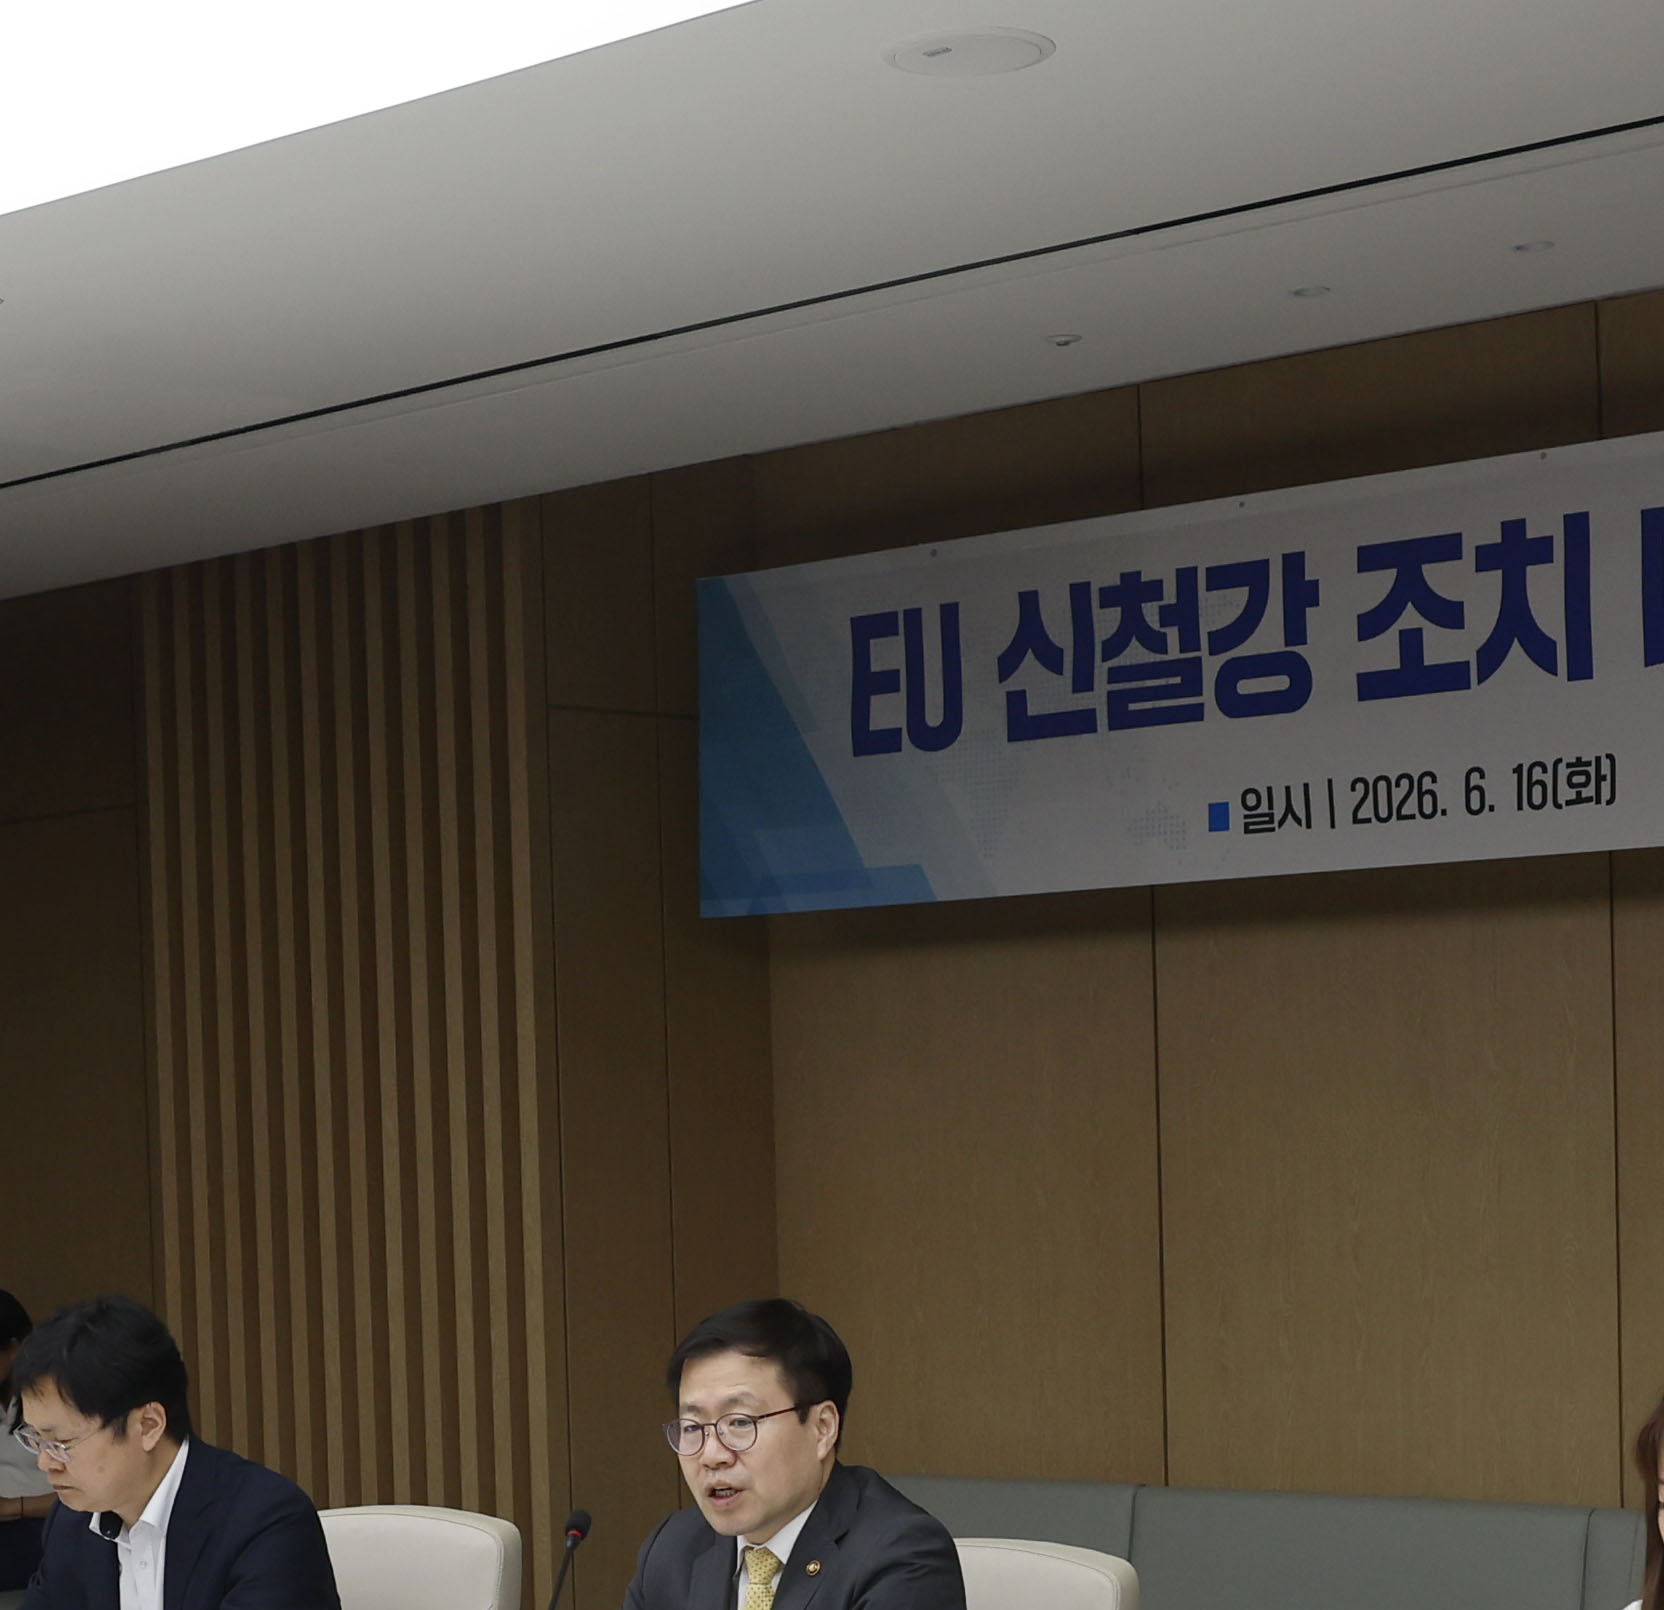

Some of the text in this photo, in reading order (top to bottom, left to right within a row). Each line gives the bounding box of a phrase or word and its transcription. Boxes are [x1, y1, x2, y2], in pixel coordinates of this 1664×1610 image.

[850, 602, 962, 757] EU
[997, 551, 1319, 742] 신철강
[1356, 511, 1593, 701] 조치
[1241, 754, 1616, 834] 일시 2026. 6. 16(화)
